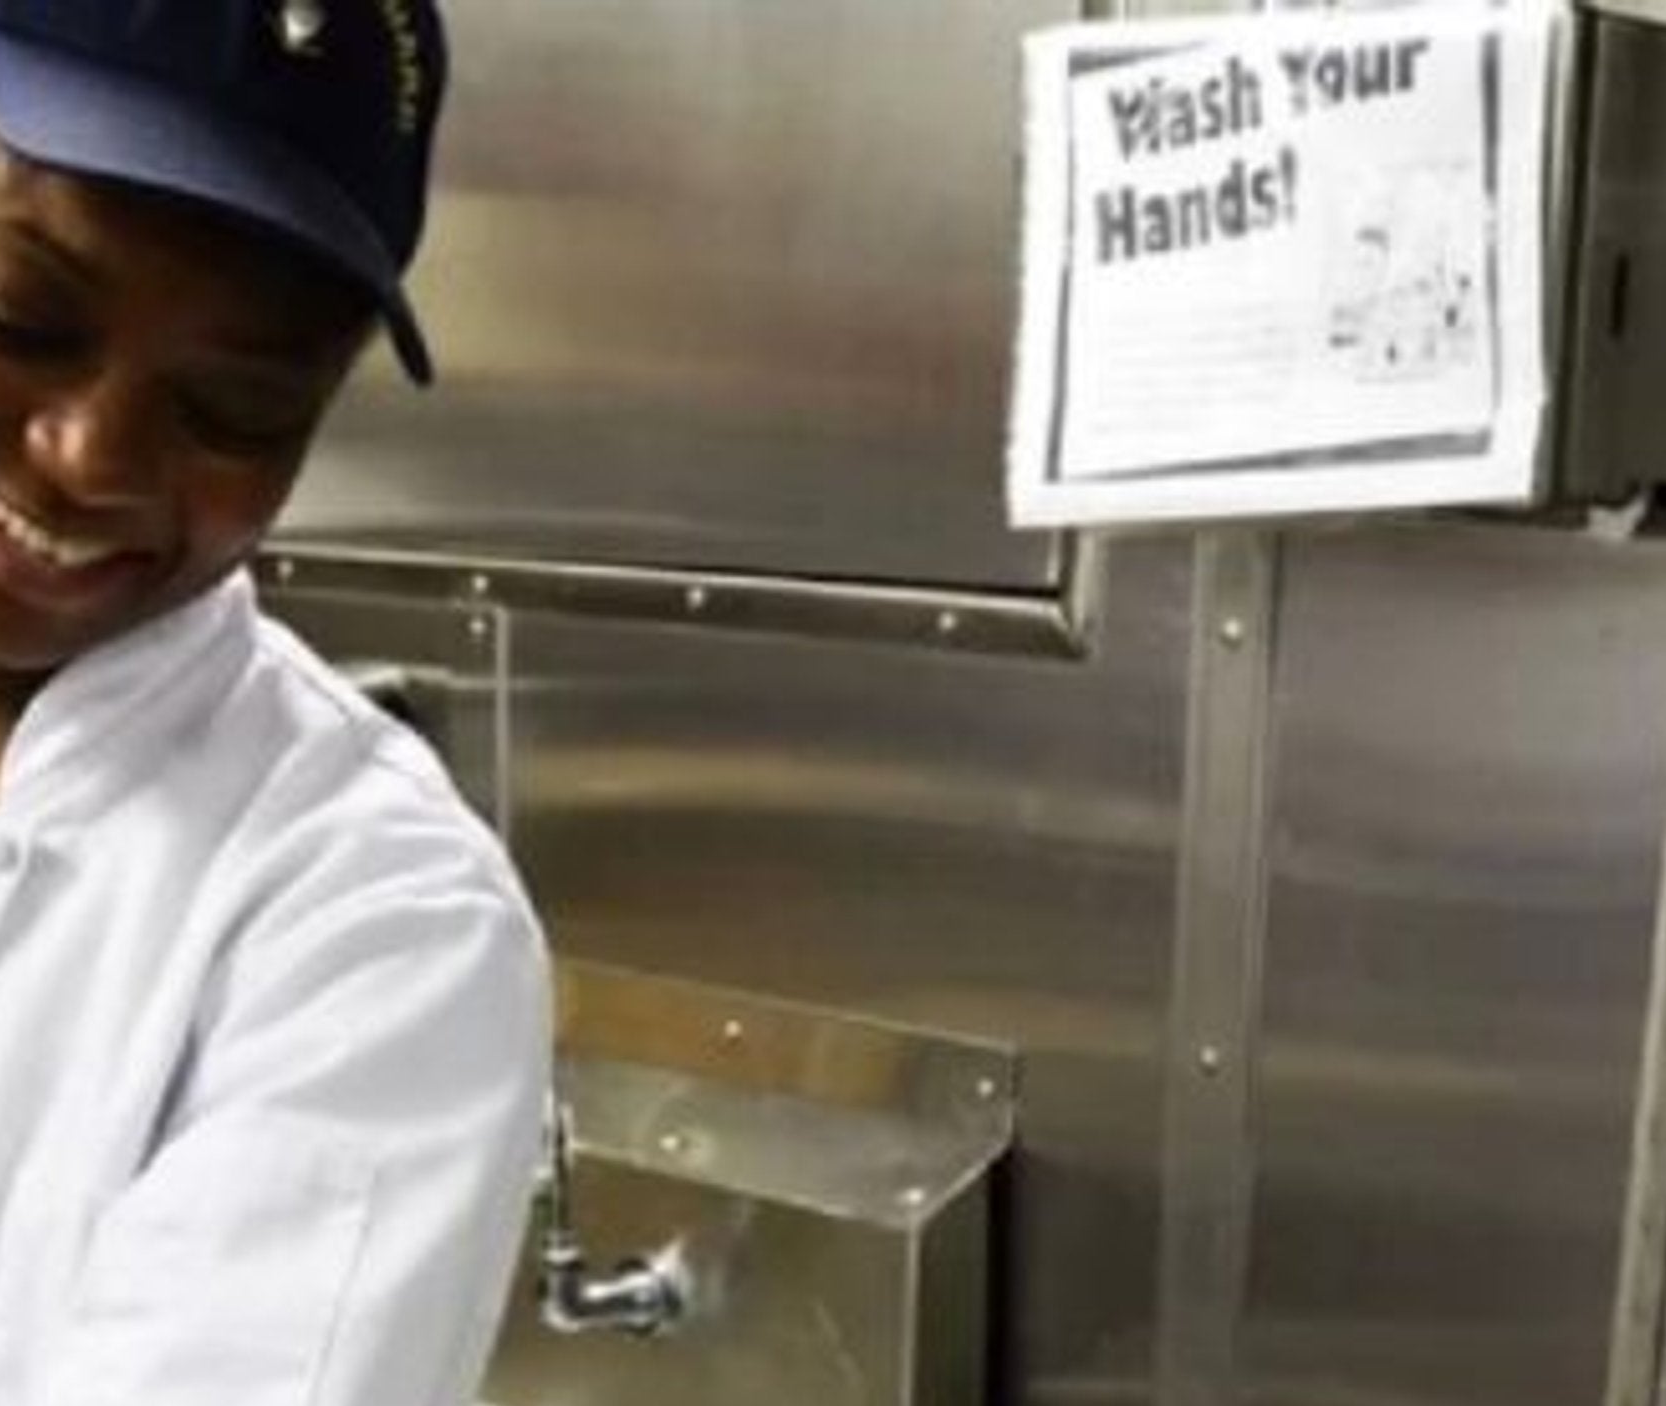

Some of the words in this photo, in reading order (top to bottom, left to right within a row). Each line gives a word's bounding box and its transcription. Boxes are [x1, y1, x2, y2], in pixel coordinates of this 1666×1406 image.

[1108, 55, 1264, 160] Wash
[1279, 38, 1429, 116] Your
[1094, 145, 1298, 265] Hands!
